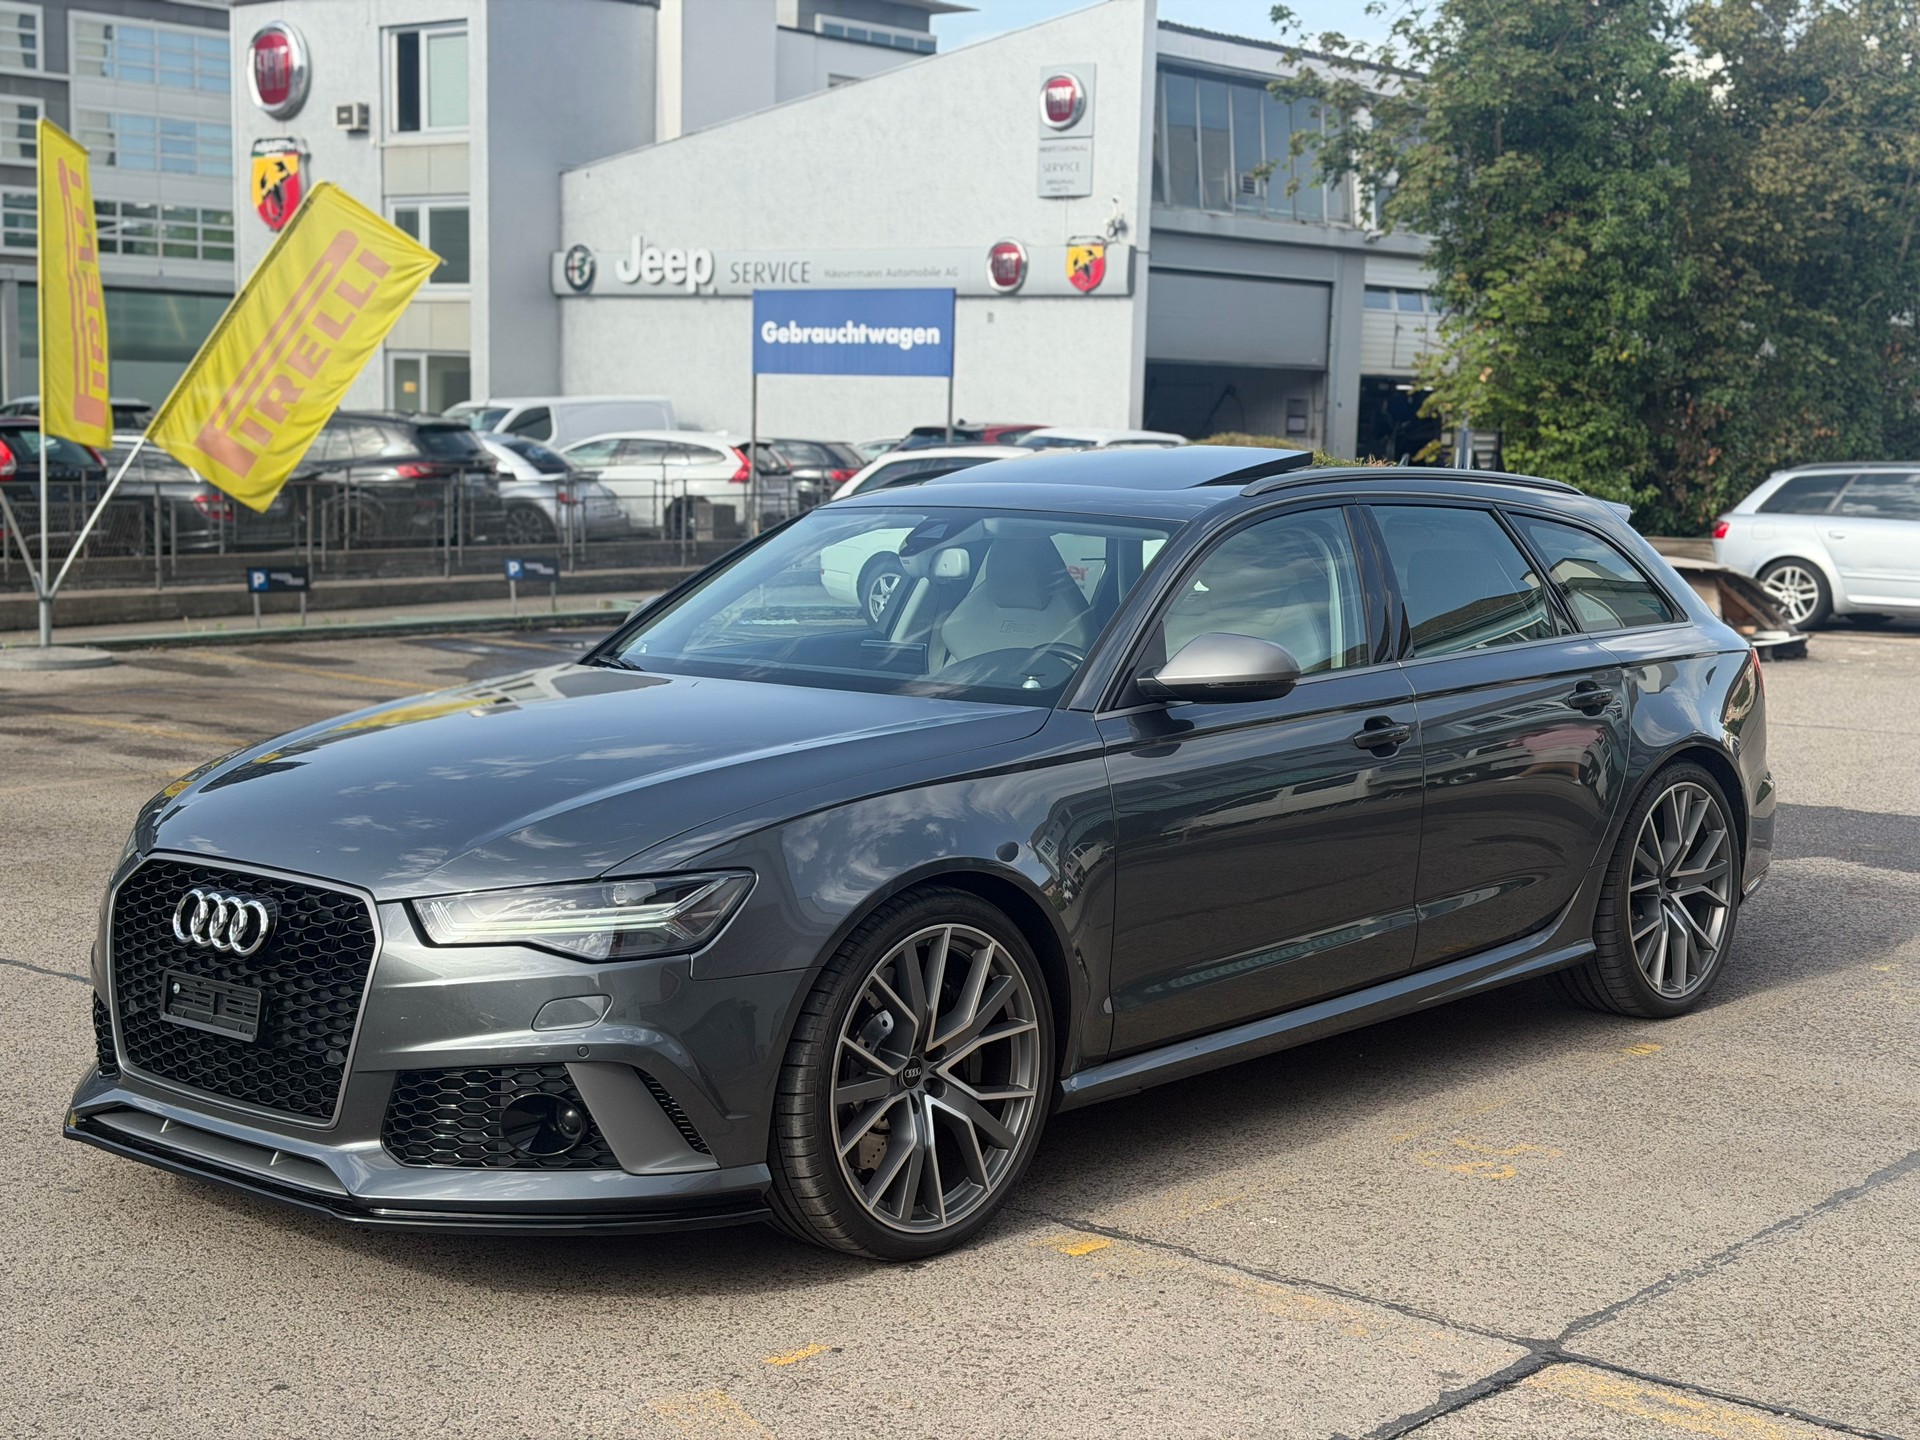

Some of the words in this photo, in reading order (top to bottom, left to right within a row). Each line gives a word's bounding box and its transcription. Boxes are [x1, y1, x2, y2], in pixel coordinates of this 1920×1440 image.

[256, 47, 289, 91] FIAT
[1043, 161, 1081, 174] SERVICE
[615, 235, 713, 294] Jeep
[730, 261, 812, 284] SERVICE
[945, 267, 958, 277] AG
[761, 320, 941, 350] Gebrauchtwagen
[193, 228, 392, 480] PIRELLI
[509, 560, 520, 574] P
[252, 571, 266, 588] P
